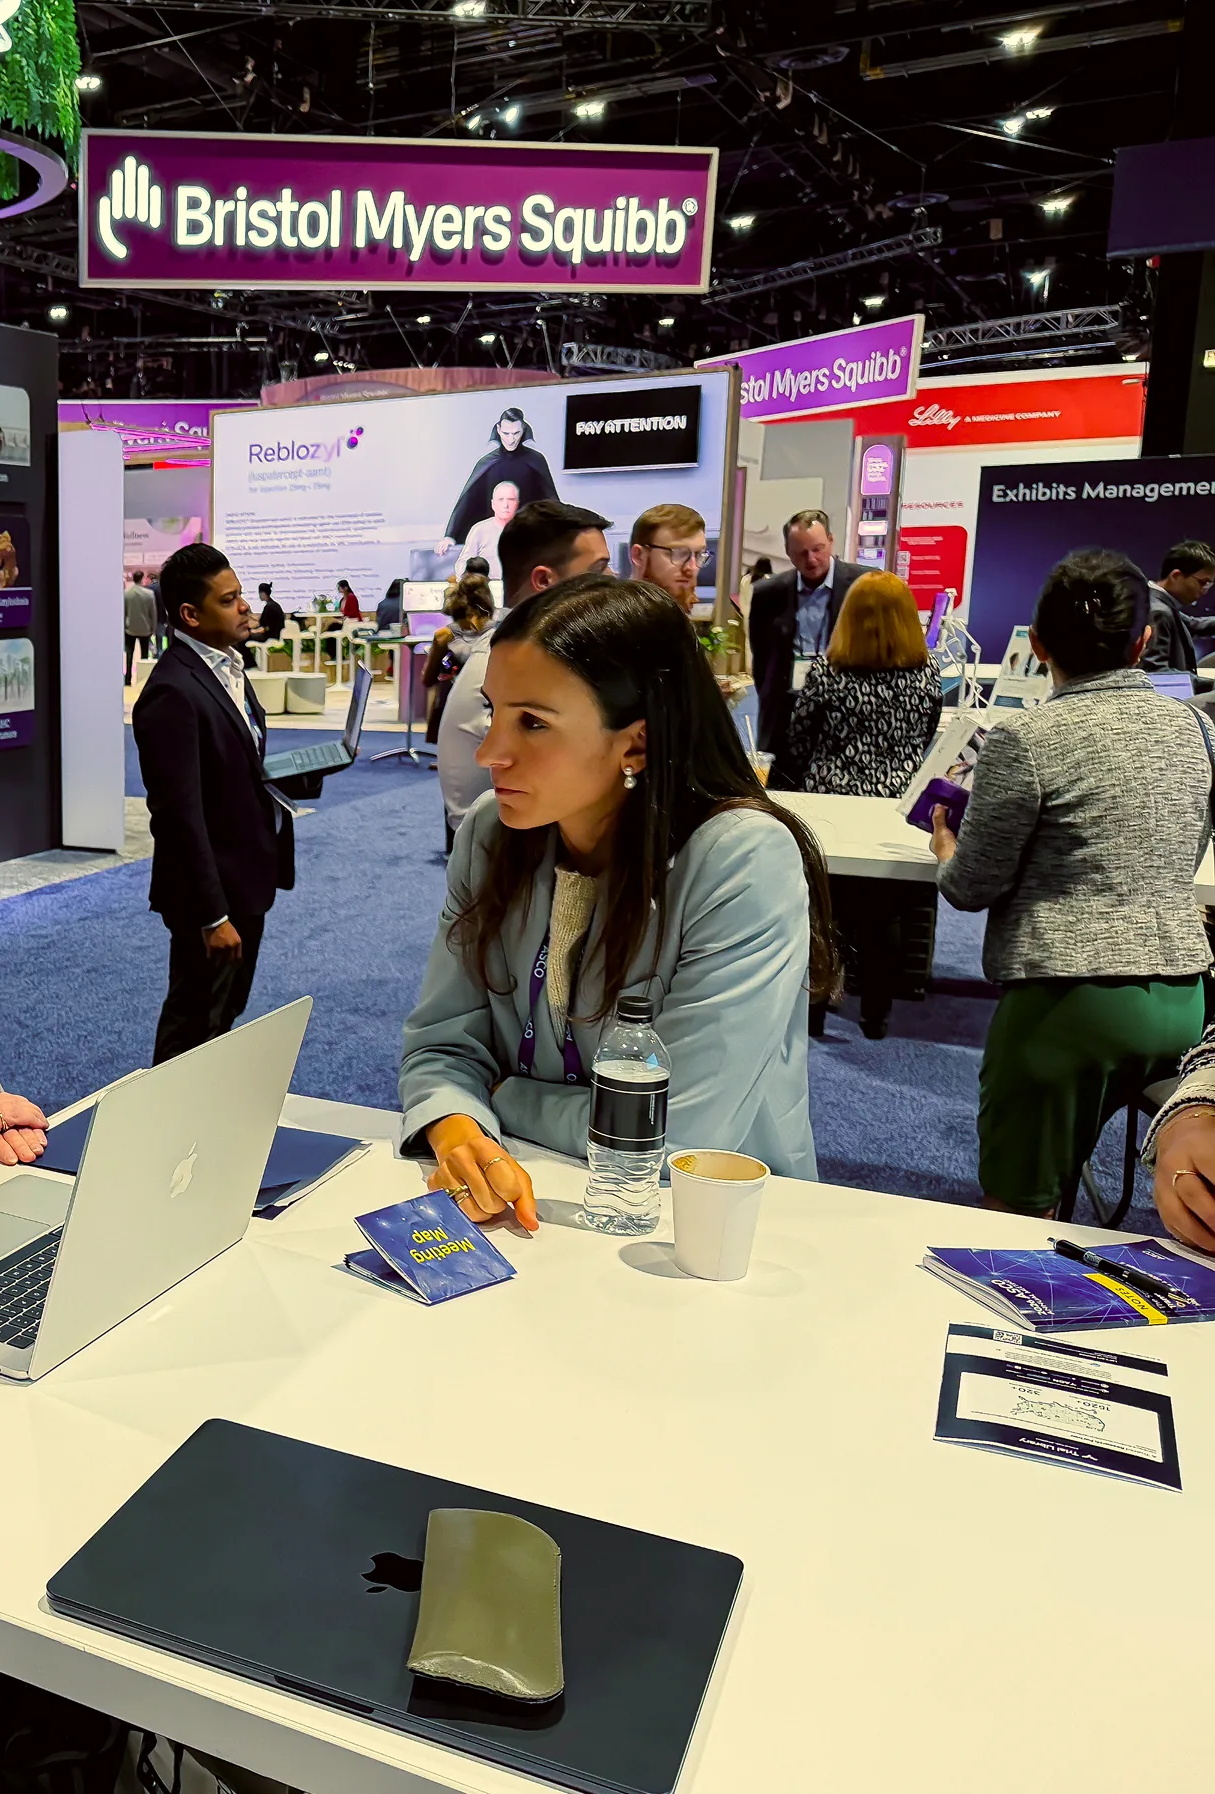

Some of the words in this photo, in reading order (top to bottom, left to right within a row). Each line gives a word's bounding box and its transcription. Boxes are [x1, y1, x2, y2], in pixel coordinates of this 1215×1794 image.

[175, 185, 341, 249] Bristol
[354, 189, 513, 262] Myers
[772, 367, 830, 402] Myers
[576, 420, 605, 436] PAY
[605, 415, 687, 434] ATTENTION
[908, 403, 961, 431] Lilly
[964, 415, 972, 423] A
[972, 412, 1015, 423] MEDICINE
[1015, 410, 1062, 421] COMPANY
[249, 438, 342, 465] Reblozyl
[991, 482, 1077, 503] Exhibits
[411, 1226, 449, 1244] Map
[409, 1237, 476, 1264] Meeting
[991, 1279, 1031, 1300] ASCO
[1115, 1287, 1149, 1311] NOTES
[1018, 1437, 1056, 1452] Library
[1057, 1446, 1080, 1458] Trial
